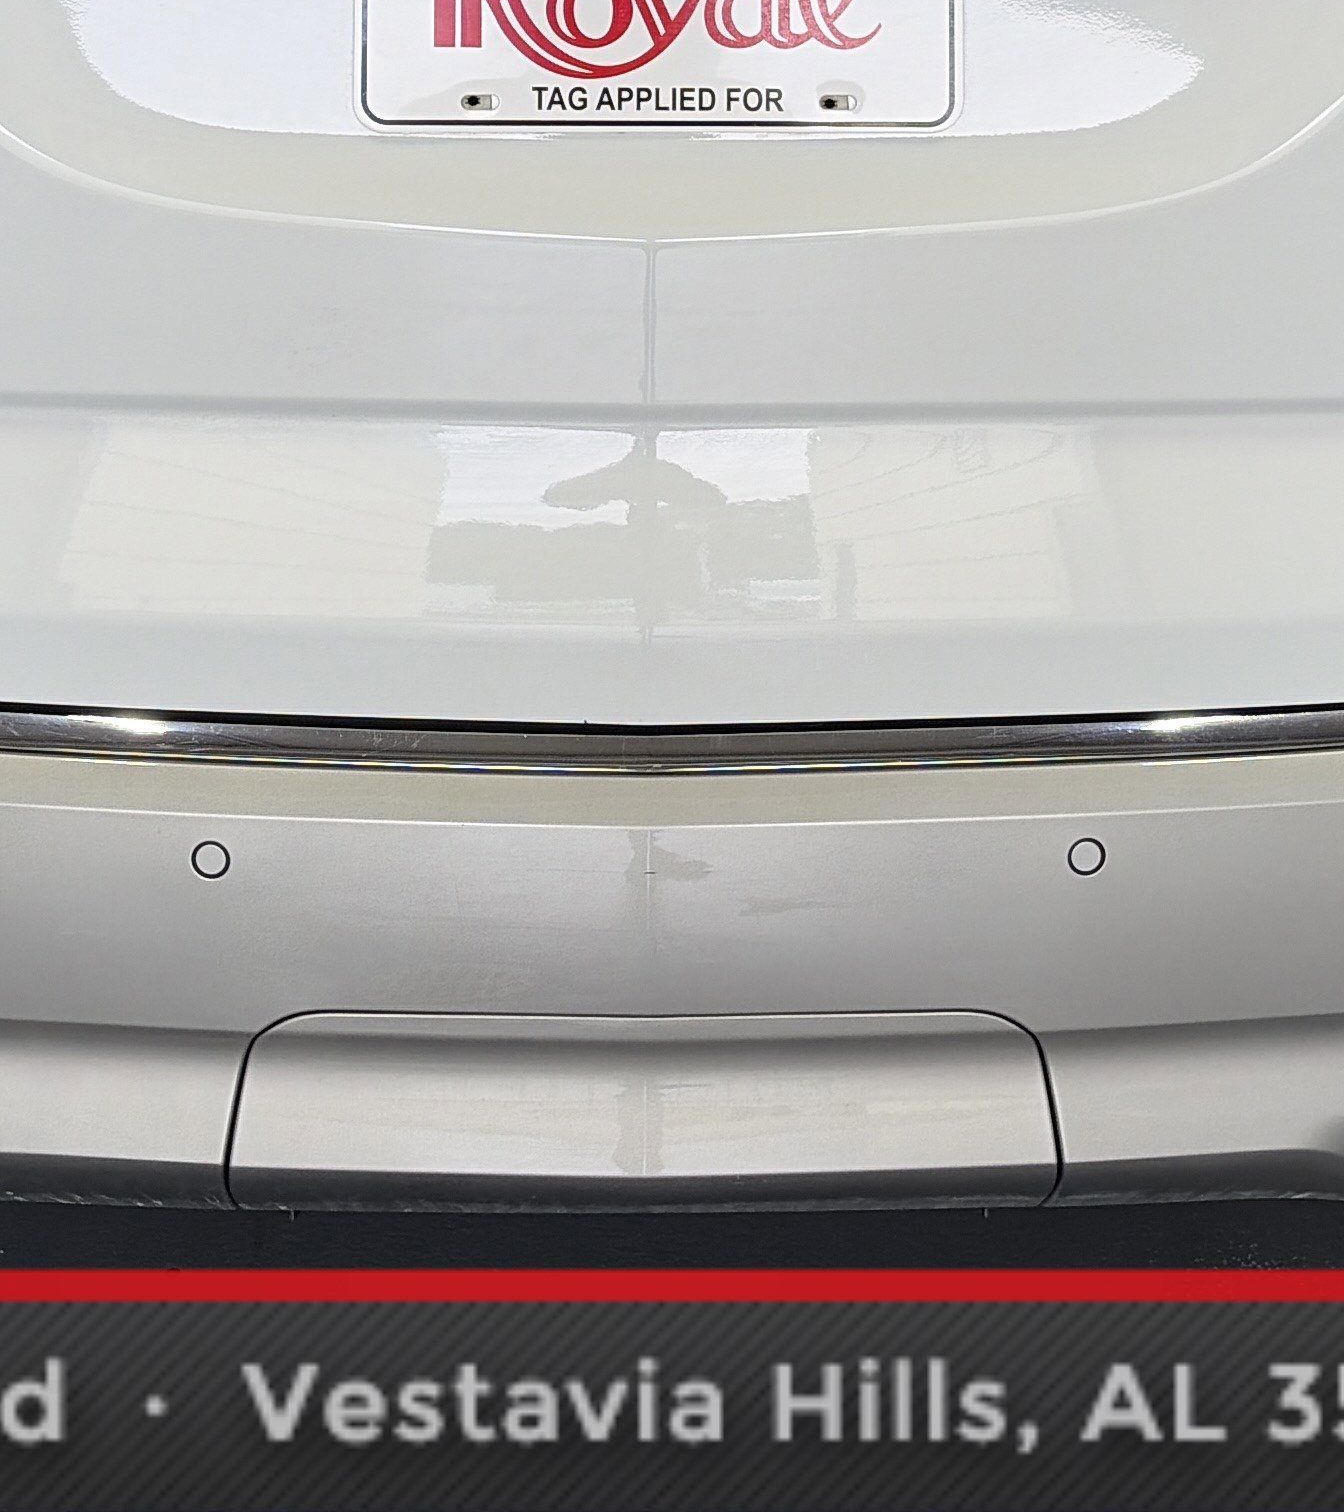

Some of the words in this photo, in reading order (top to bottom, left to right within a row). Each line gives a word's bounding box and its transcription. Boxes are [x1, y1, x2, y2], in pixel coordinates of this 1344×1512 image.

[531, 86, 588, 112] TAG
[595, 86, 717, 112] APPLIED
[726, 86, 784, 113] FOR
